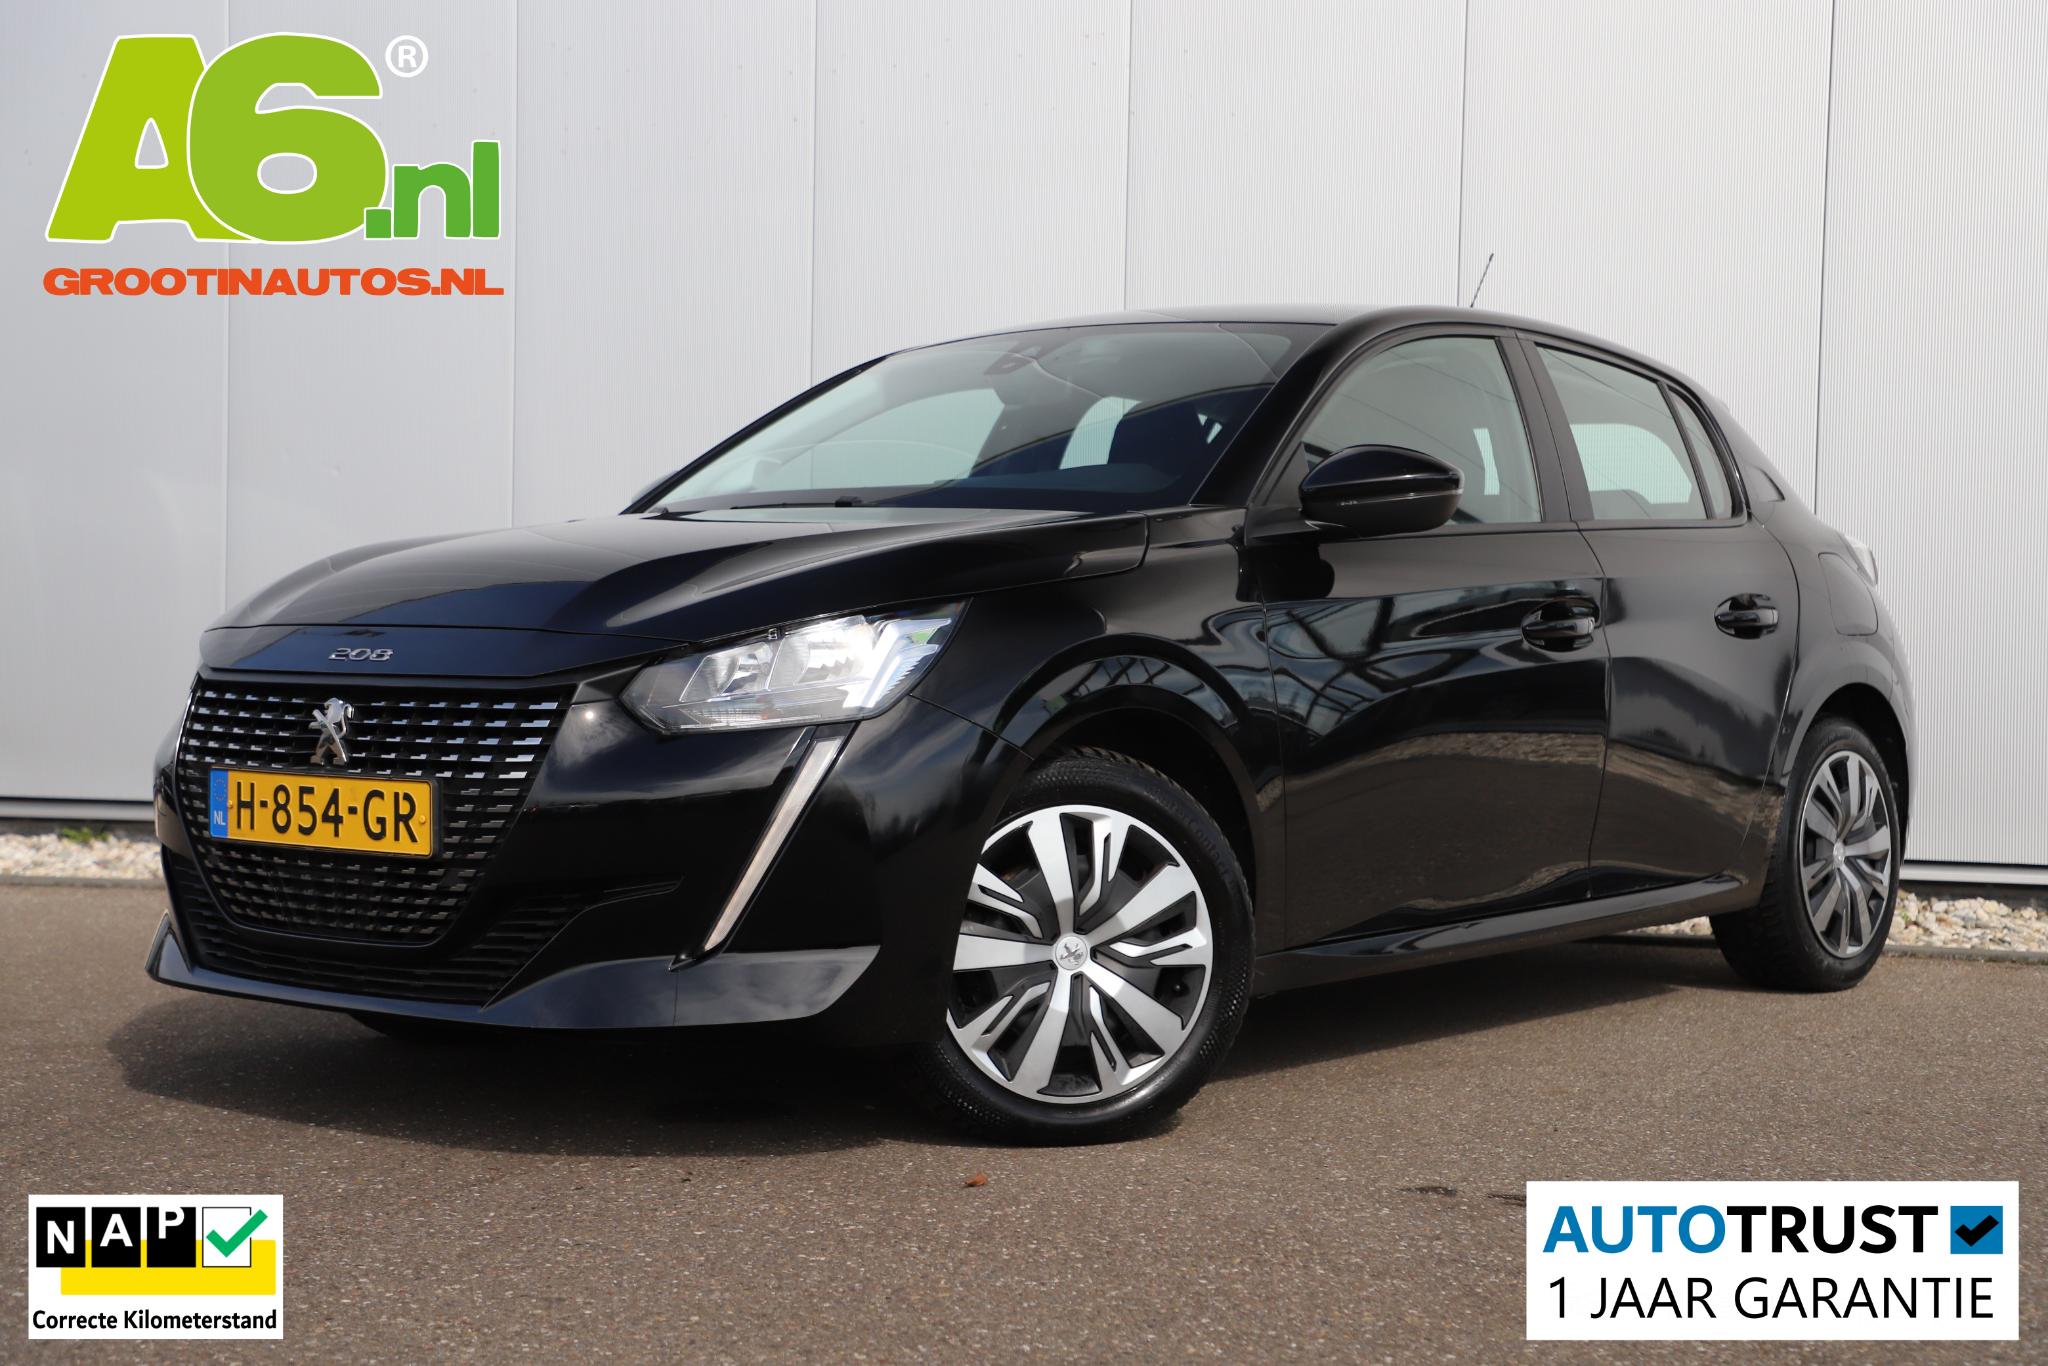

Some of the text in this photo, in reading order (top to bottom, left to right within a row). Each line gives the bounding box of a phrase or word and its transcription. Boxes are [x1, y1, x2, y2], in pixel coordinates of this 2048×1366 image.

[328, 647, 393, 661] 208
[213, 810, 226, 825] NL
[236, 781, 418, 843] H-854-GR
